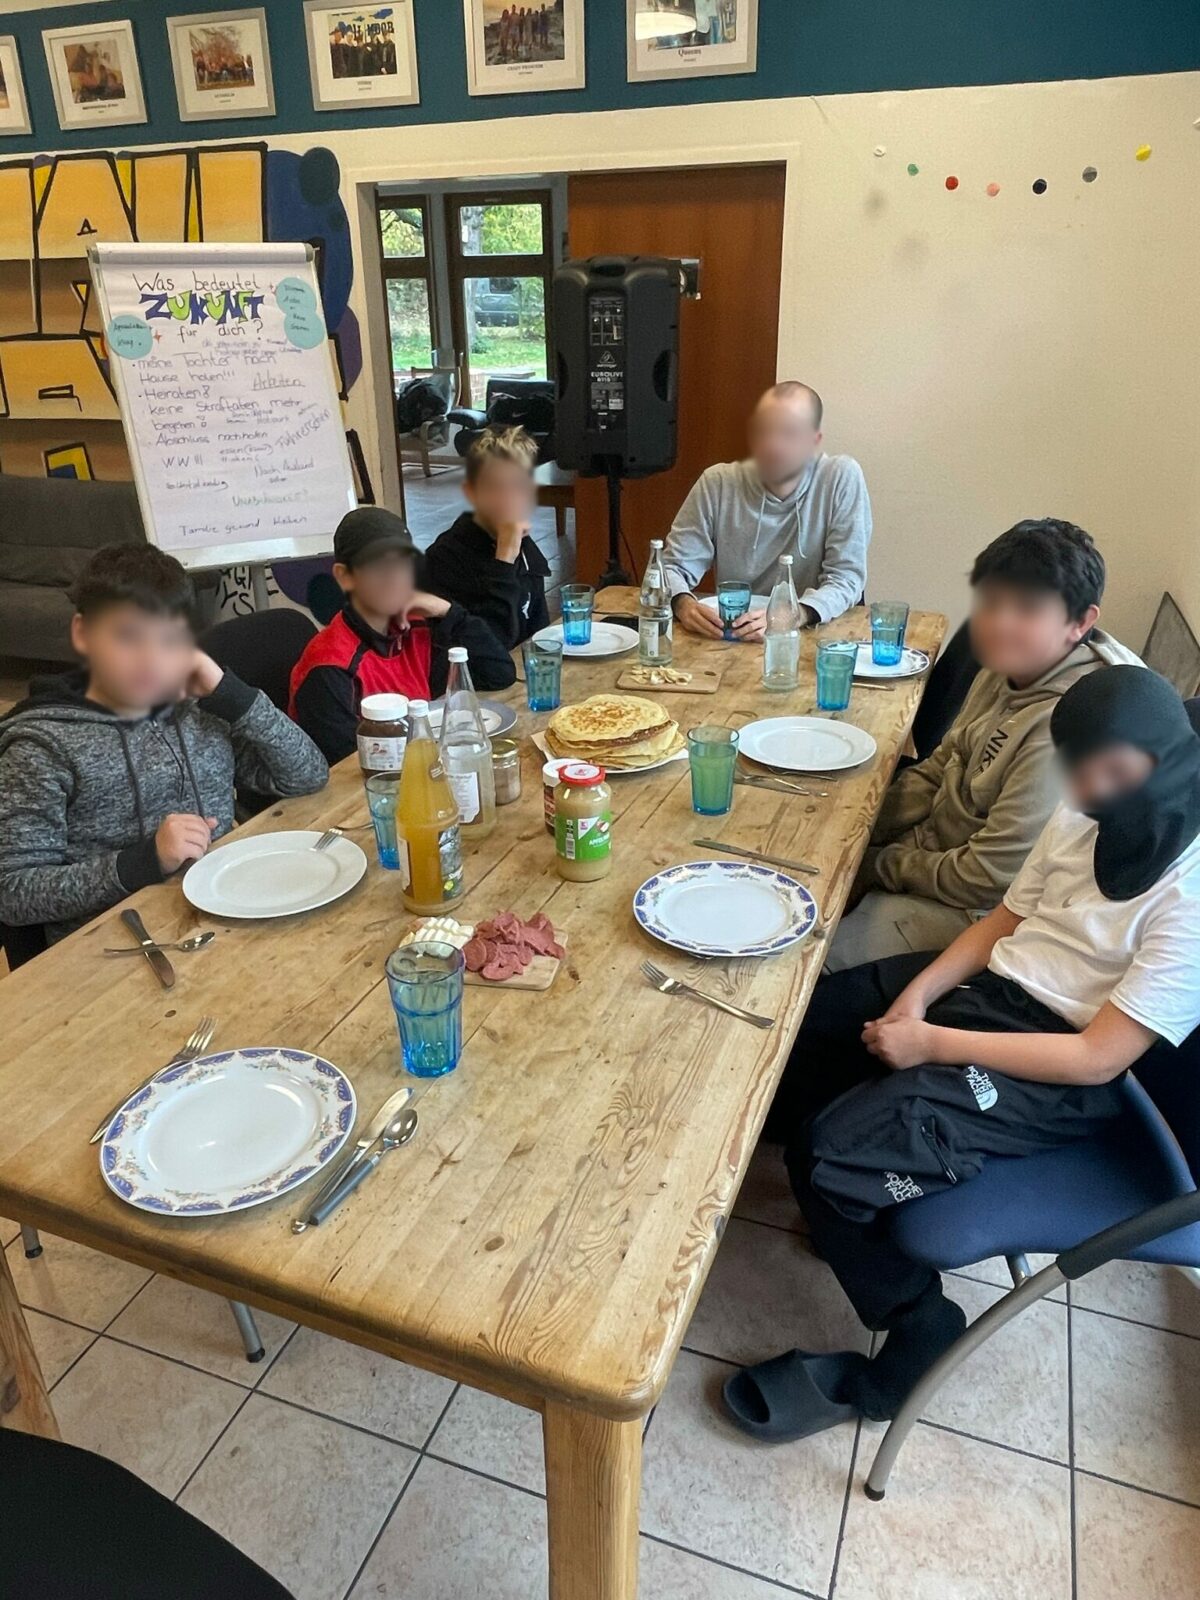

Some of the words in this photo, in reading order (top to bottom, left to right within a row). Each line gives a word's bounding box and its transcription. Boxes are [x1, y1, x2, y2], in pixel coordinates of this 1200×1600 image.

[133, 272, 175, 291] Was
[139, 289, 265, 326] ZUKUNFT
[218, 322, 246, 336] dich
[148, 404, 184, 416] keine
[966, 1074, 982, 1096] FACE
[968, 1065, 989, 1093] NORTH
[981, 1072, 995, 1090] THE
[903, 1175, 923, 1196] THE
